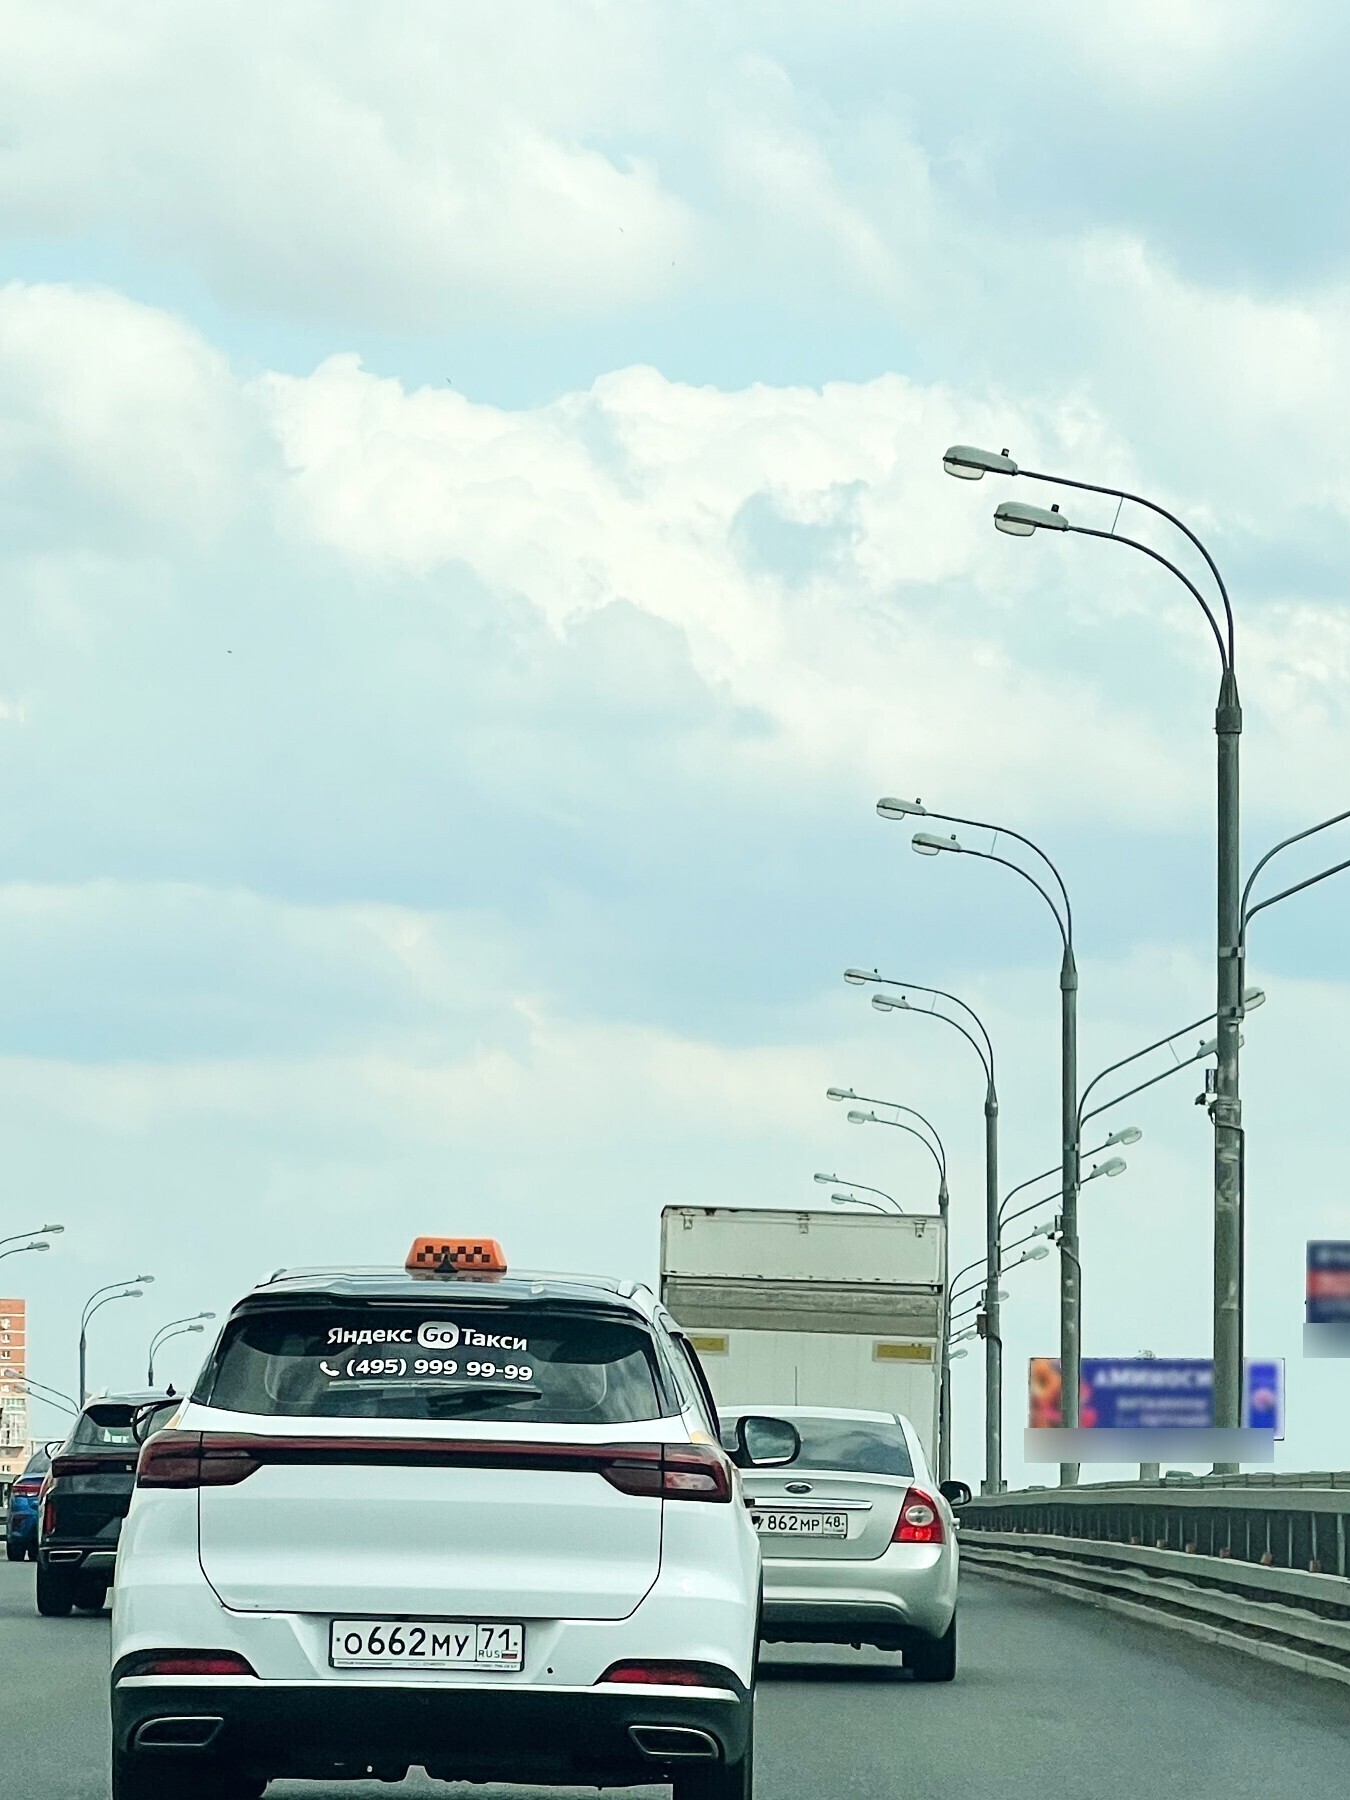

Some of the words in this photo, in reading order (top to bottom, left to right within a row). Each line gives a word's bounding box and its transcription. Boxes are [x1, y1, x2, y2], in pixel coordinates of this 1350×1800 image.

[327, 1327, 413, 1346] Яндекс
[423, 1326, 455, 1343] Go
[461, 1328, 528, 1351] Такси
[346, 1358, 407, 1377] (495)
[414, 1359, 458, 1375] 999
[466, 1361, 533, 1381] 99-99
[825, 1515, 841, 1528] 48
[481, 1628, 511, 1651] 71
[478, 1650, 501, 1659] RUS
